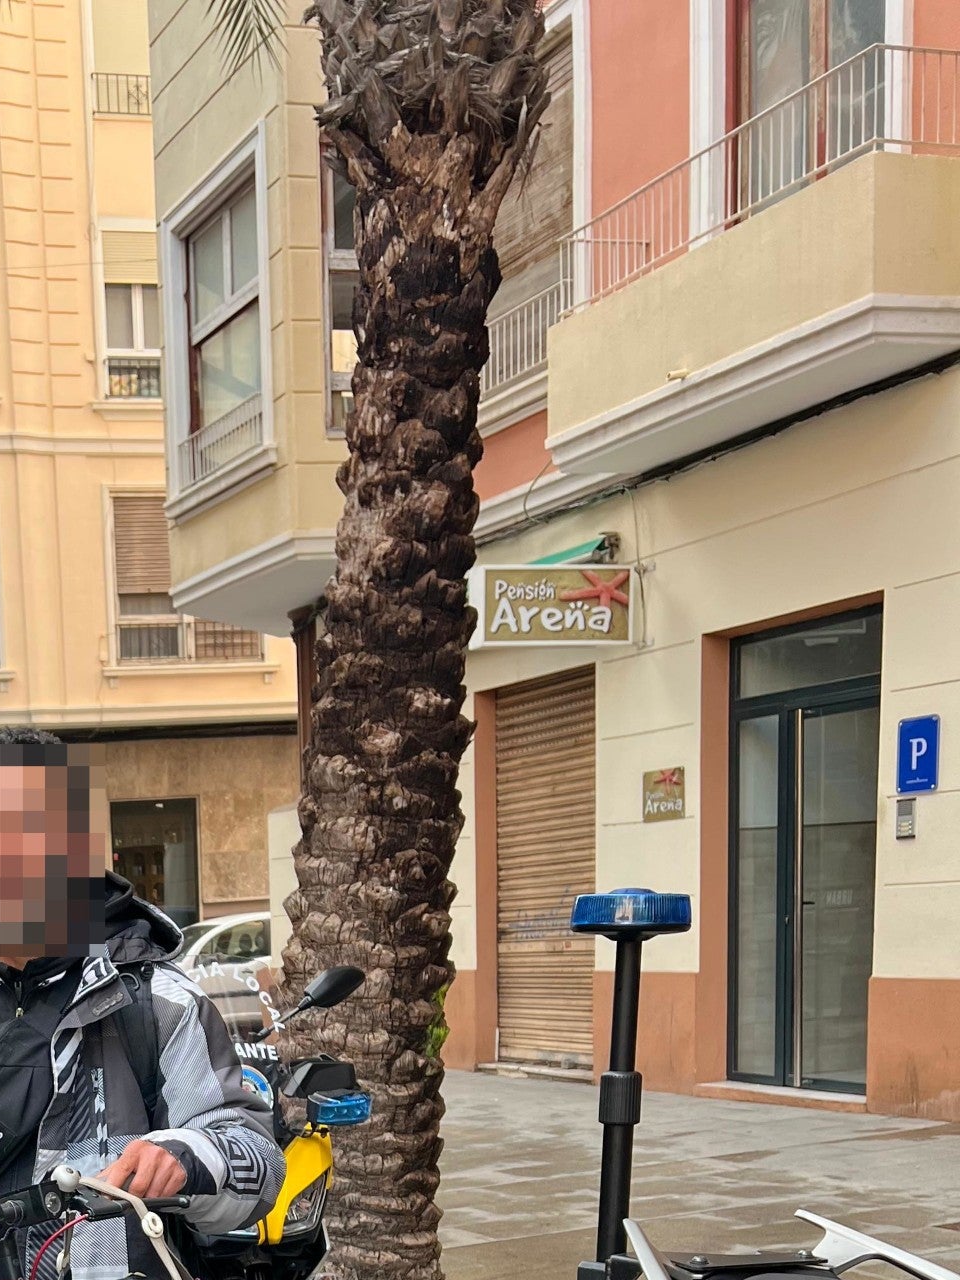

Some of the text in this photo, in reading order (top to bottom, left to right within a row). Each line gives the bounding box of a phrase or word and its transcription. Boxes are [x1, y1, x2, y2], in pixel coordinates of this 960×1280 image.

[494, 578, 556, 601] Pensión
[909, 737, 927, 770] P
[235, 1042, 279, 1061] ANTE
